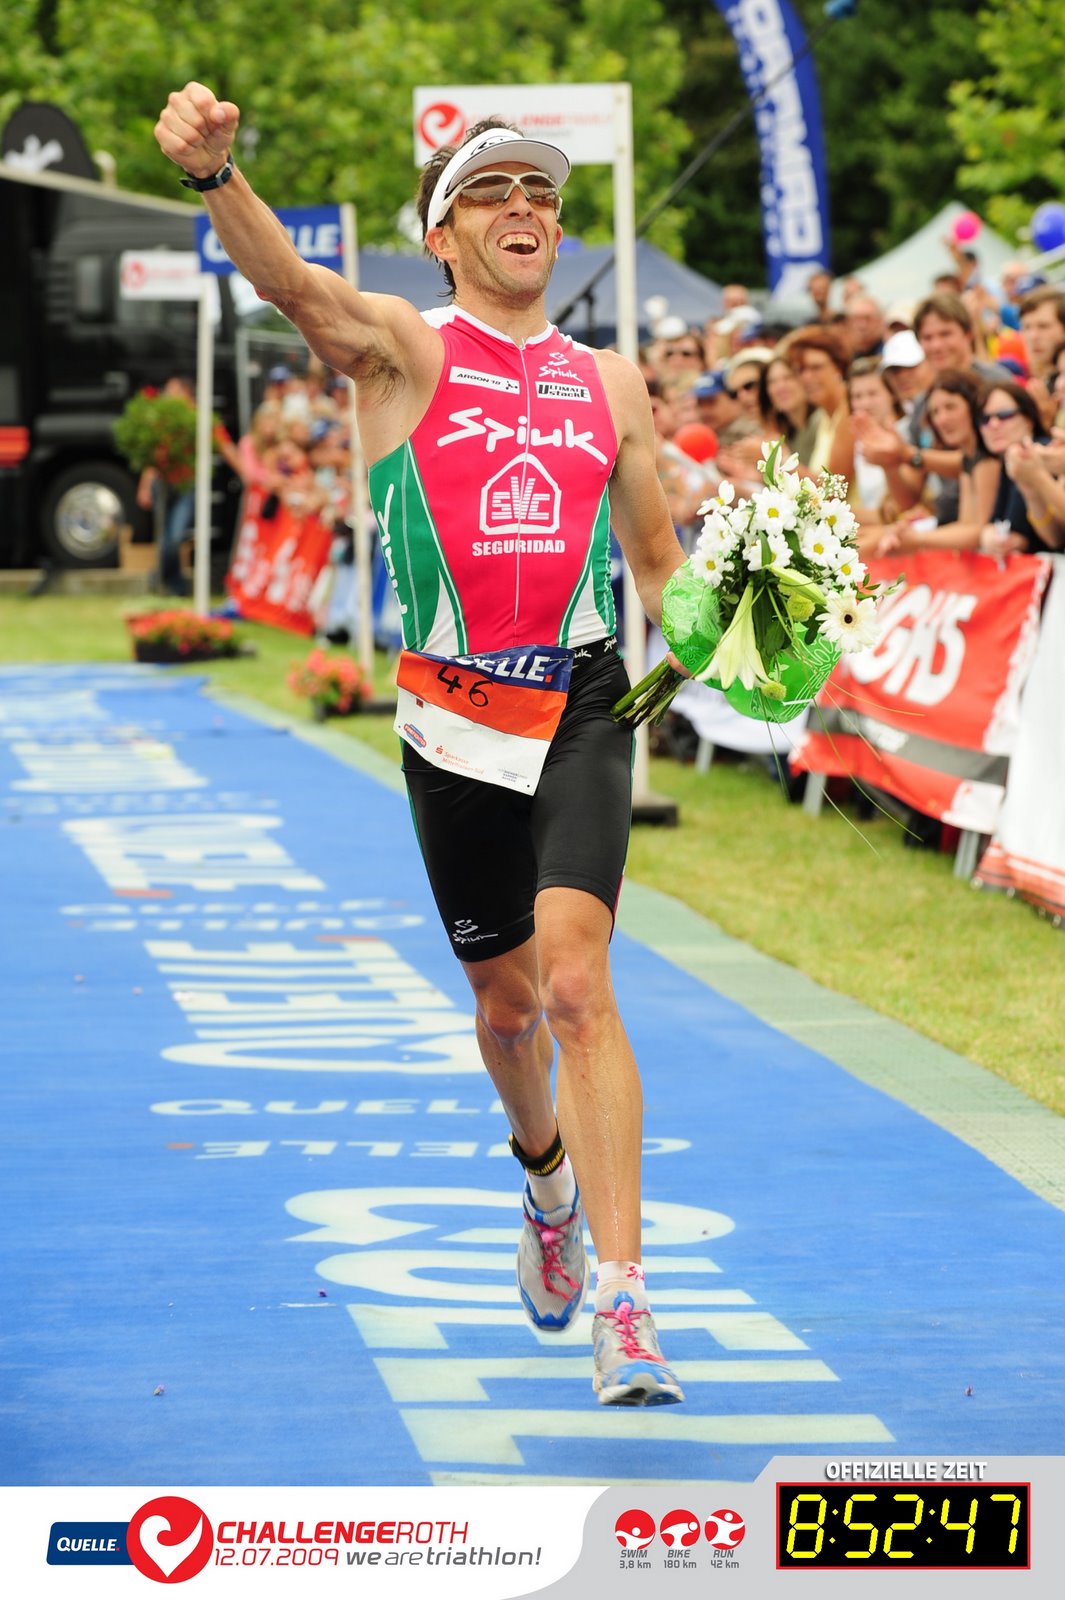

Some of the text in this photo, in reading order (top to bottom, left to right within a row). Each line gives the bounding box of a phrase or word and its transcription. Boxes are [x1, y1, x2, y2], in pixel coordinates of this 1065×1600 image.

[538, 365, 584, 383] Spiuk
[436, 406, 608, 466] Spiuk
[491, 476, 551, 520] SVC
[471, 539, 566, 558] SEGURIDAD
[437, 665, 494, 708] 46
